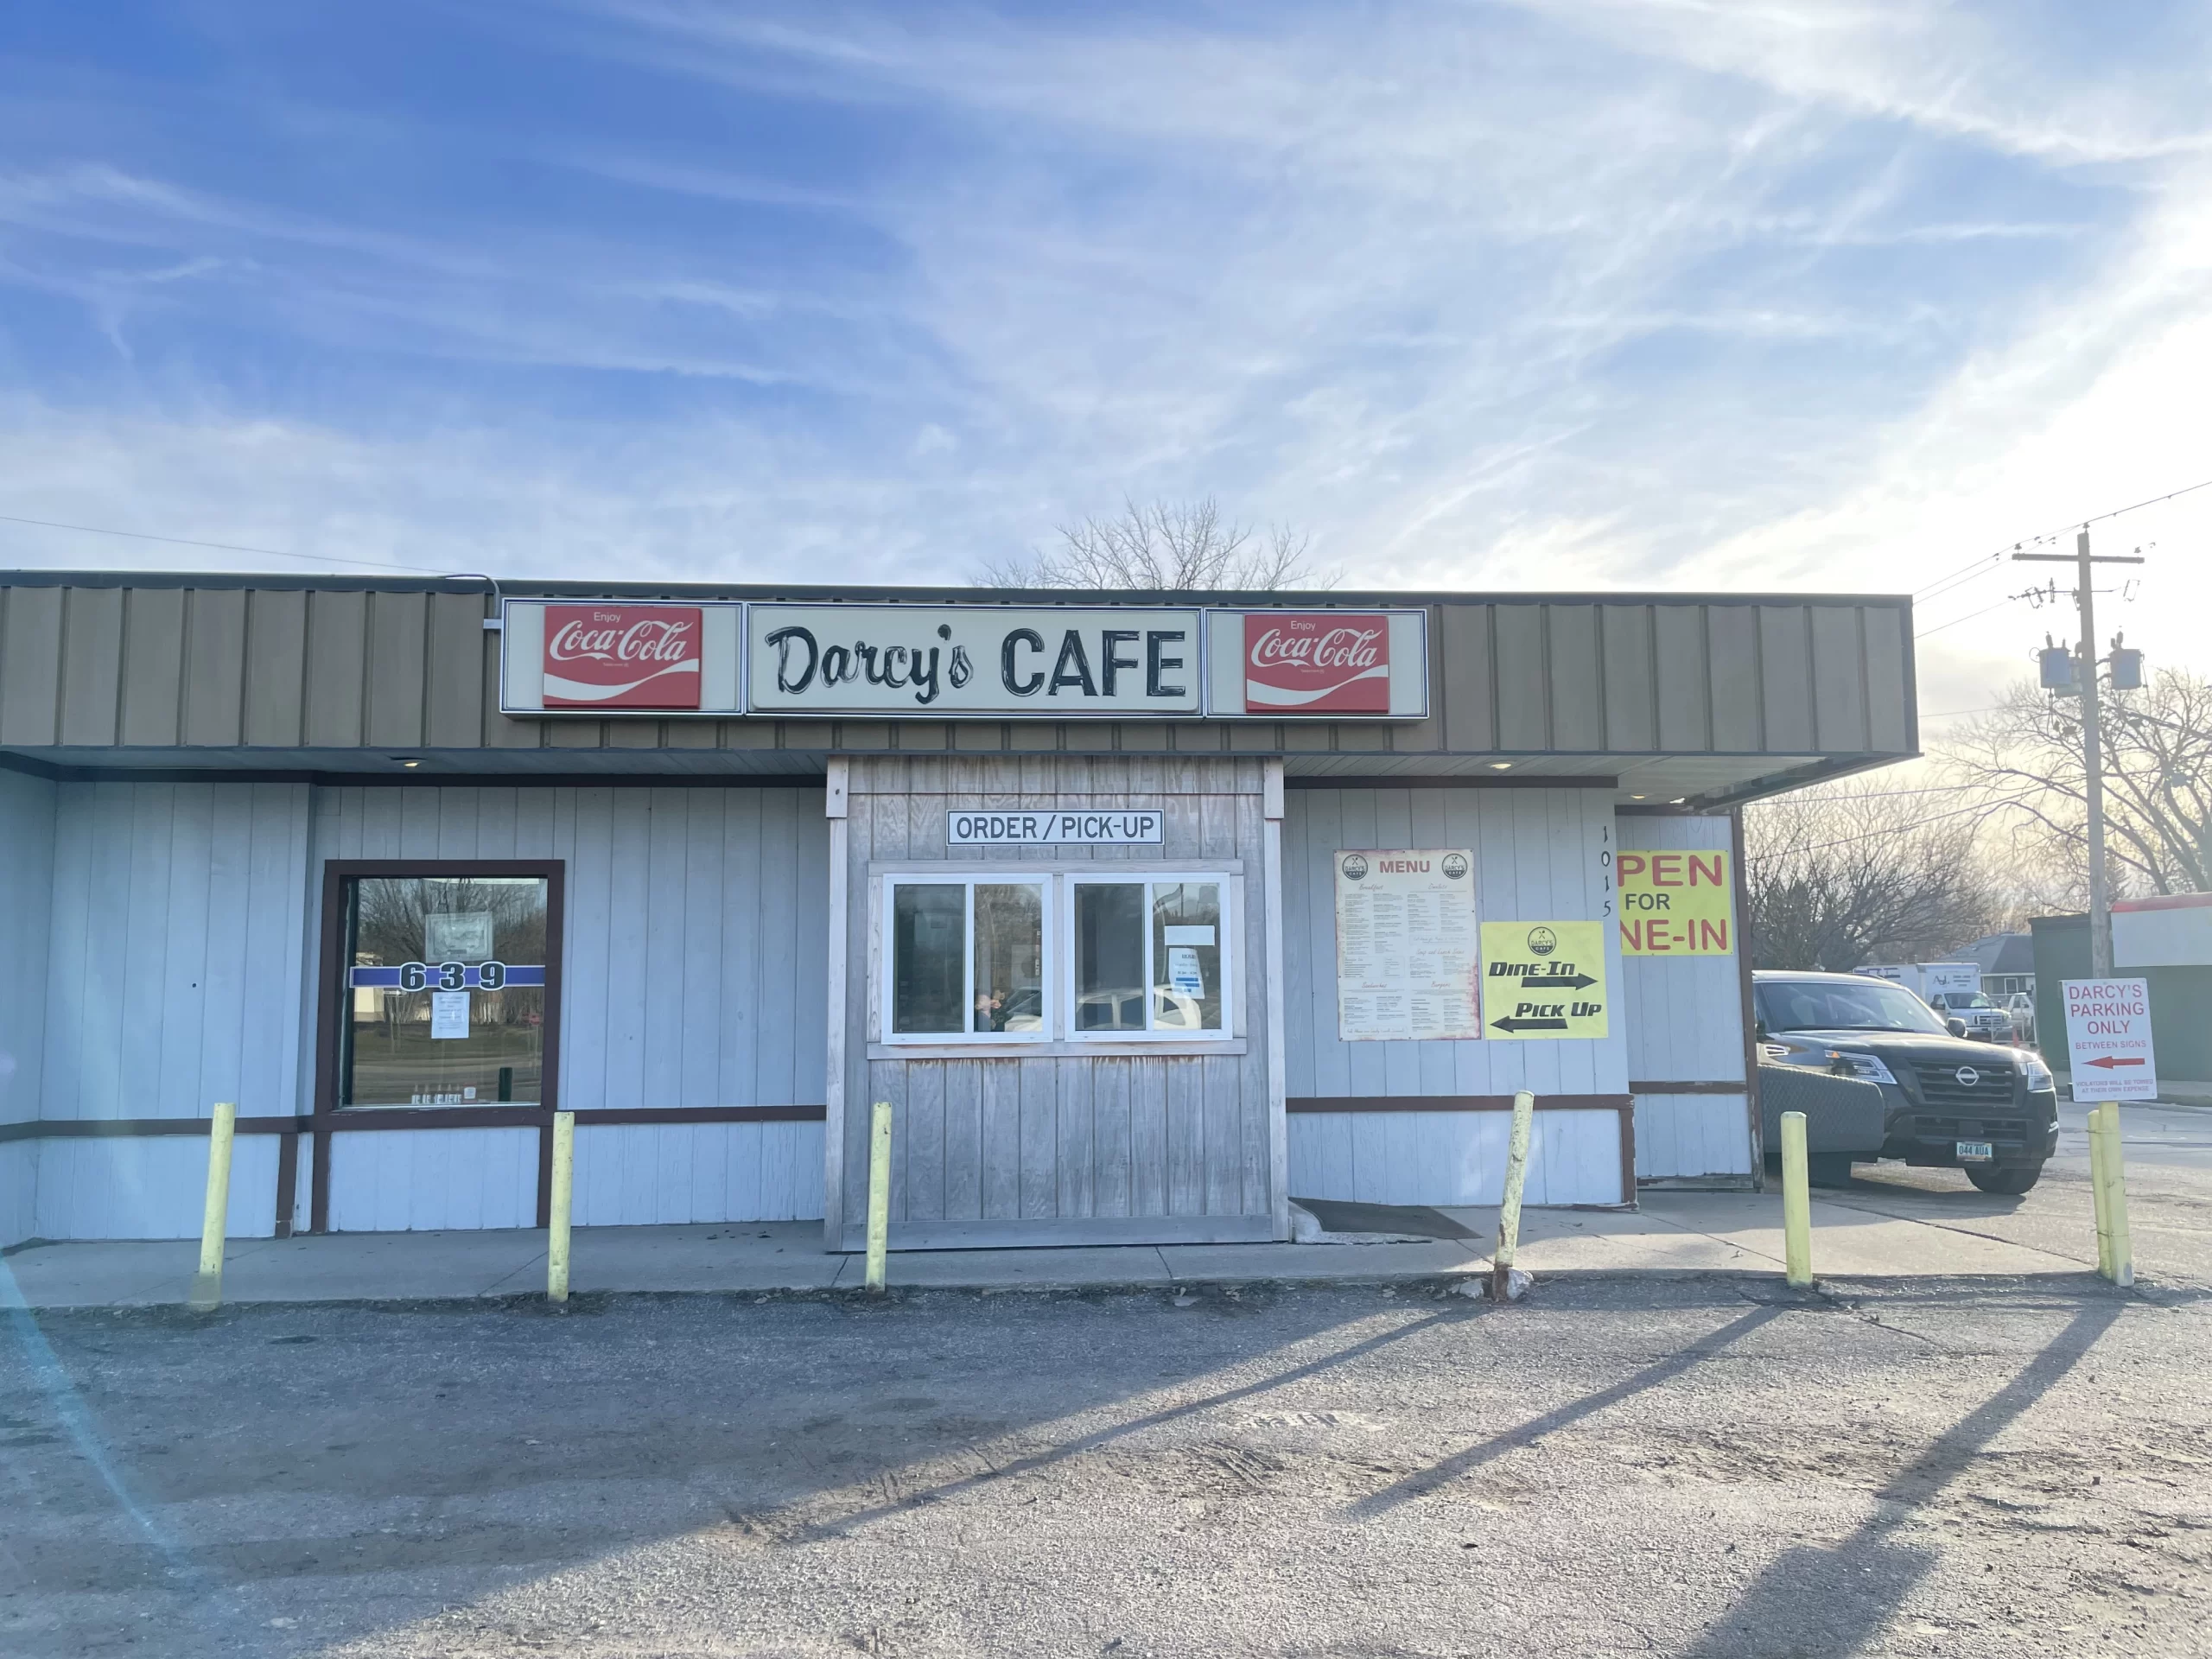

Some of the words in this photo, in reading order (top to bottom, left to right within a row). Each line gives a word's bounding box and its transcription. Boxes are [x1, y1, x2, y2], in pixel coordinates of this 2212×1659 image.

[594, 612, 621, 623] Enjoy
[1290, 620, 1316, 631] Enjoy
[549, 620, 694, 662] Coca-Cola
[1250, 627, 1383, 668] Coca-Cola
[765, 623, 974, 705] Darcy's
[1001, 627, 1186, 697] CAFE
[1379, 861, 1431, 874] MENU
[1617, 855, 1723, 887] PEN
[1625, 893, 1671, 911] FOR
[1619, 918, 1727, 951] NE-IN
[2069, 984, 2143, 1000] DARCY'S
[2070, 1002, 2145, 1017] PARKING
[2088, 1020, 2130, 1034] ONLY
[2075, 1041, 2118, 1050] BETWEEN
